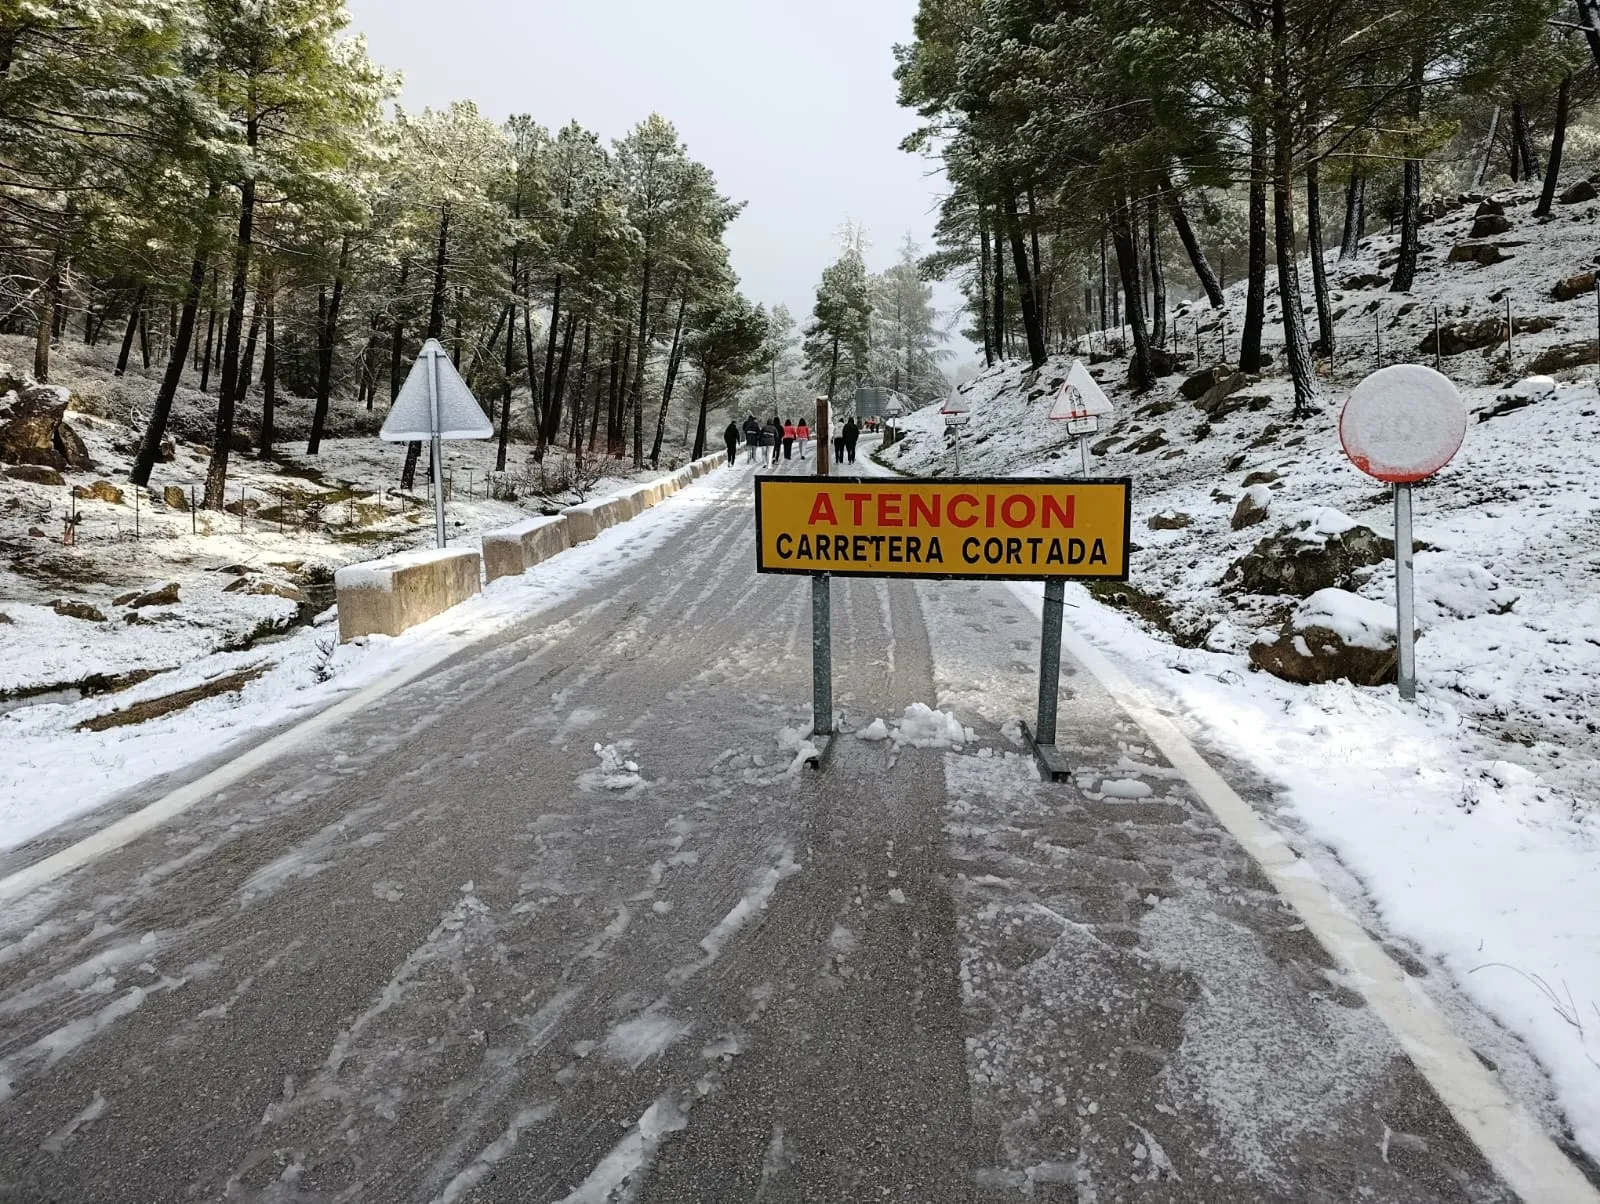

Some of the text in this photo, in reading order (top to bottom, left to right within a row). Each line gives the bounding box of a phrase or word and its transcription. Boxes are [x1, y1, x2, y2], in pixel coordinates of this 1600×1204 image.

[808, 492, 1075, 528] ATENCION
[776, 533, 1107, 565] CARRETERA CORTADA
